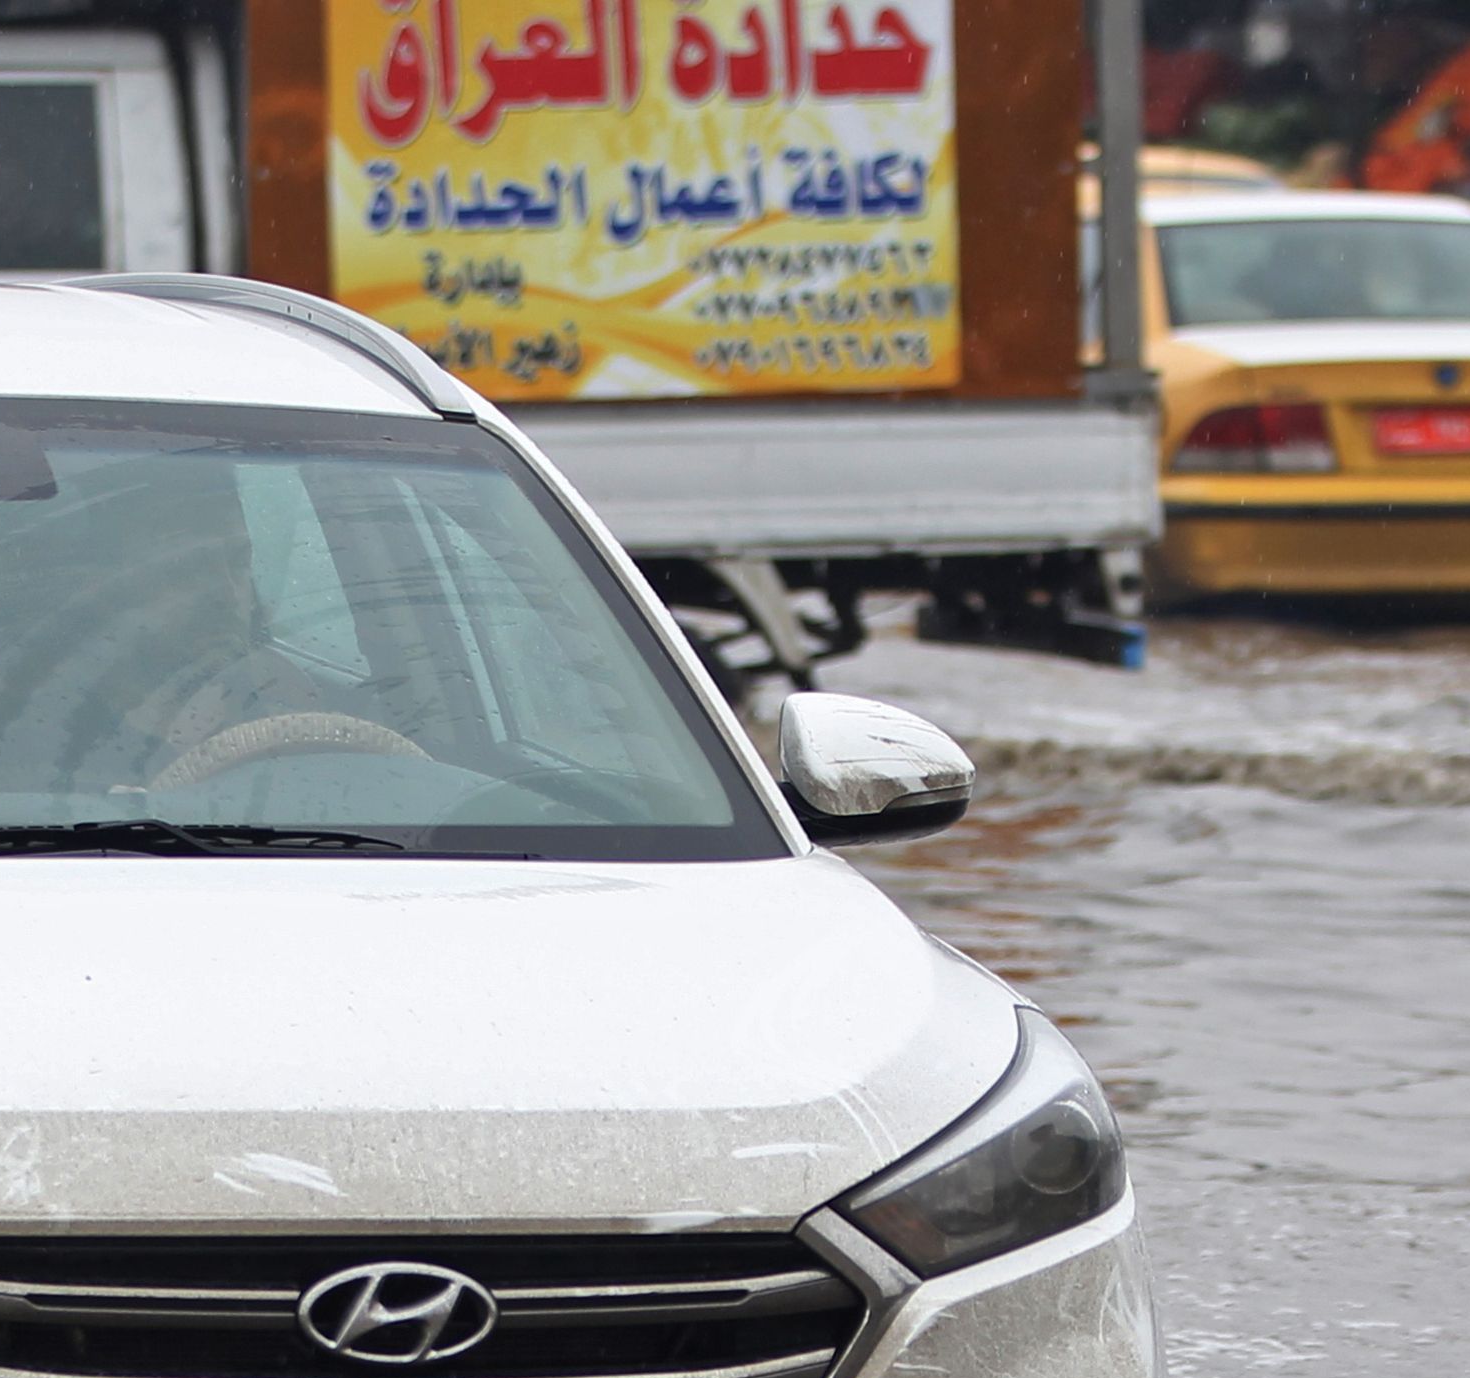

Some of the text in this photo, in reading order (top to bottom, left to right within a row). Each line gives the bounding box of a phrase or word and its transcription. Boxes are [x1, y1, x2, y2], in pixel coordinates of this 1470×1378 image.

[360, 0, 933, 146] حدادة العراق
[366, 145, 927, 243] لكافة أعمال الحدادة
